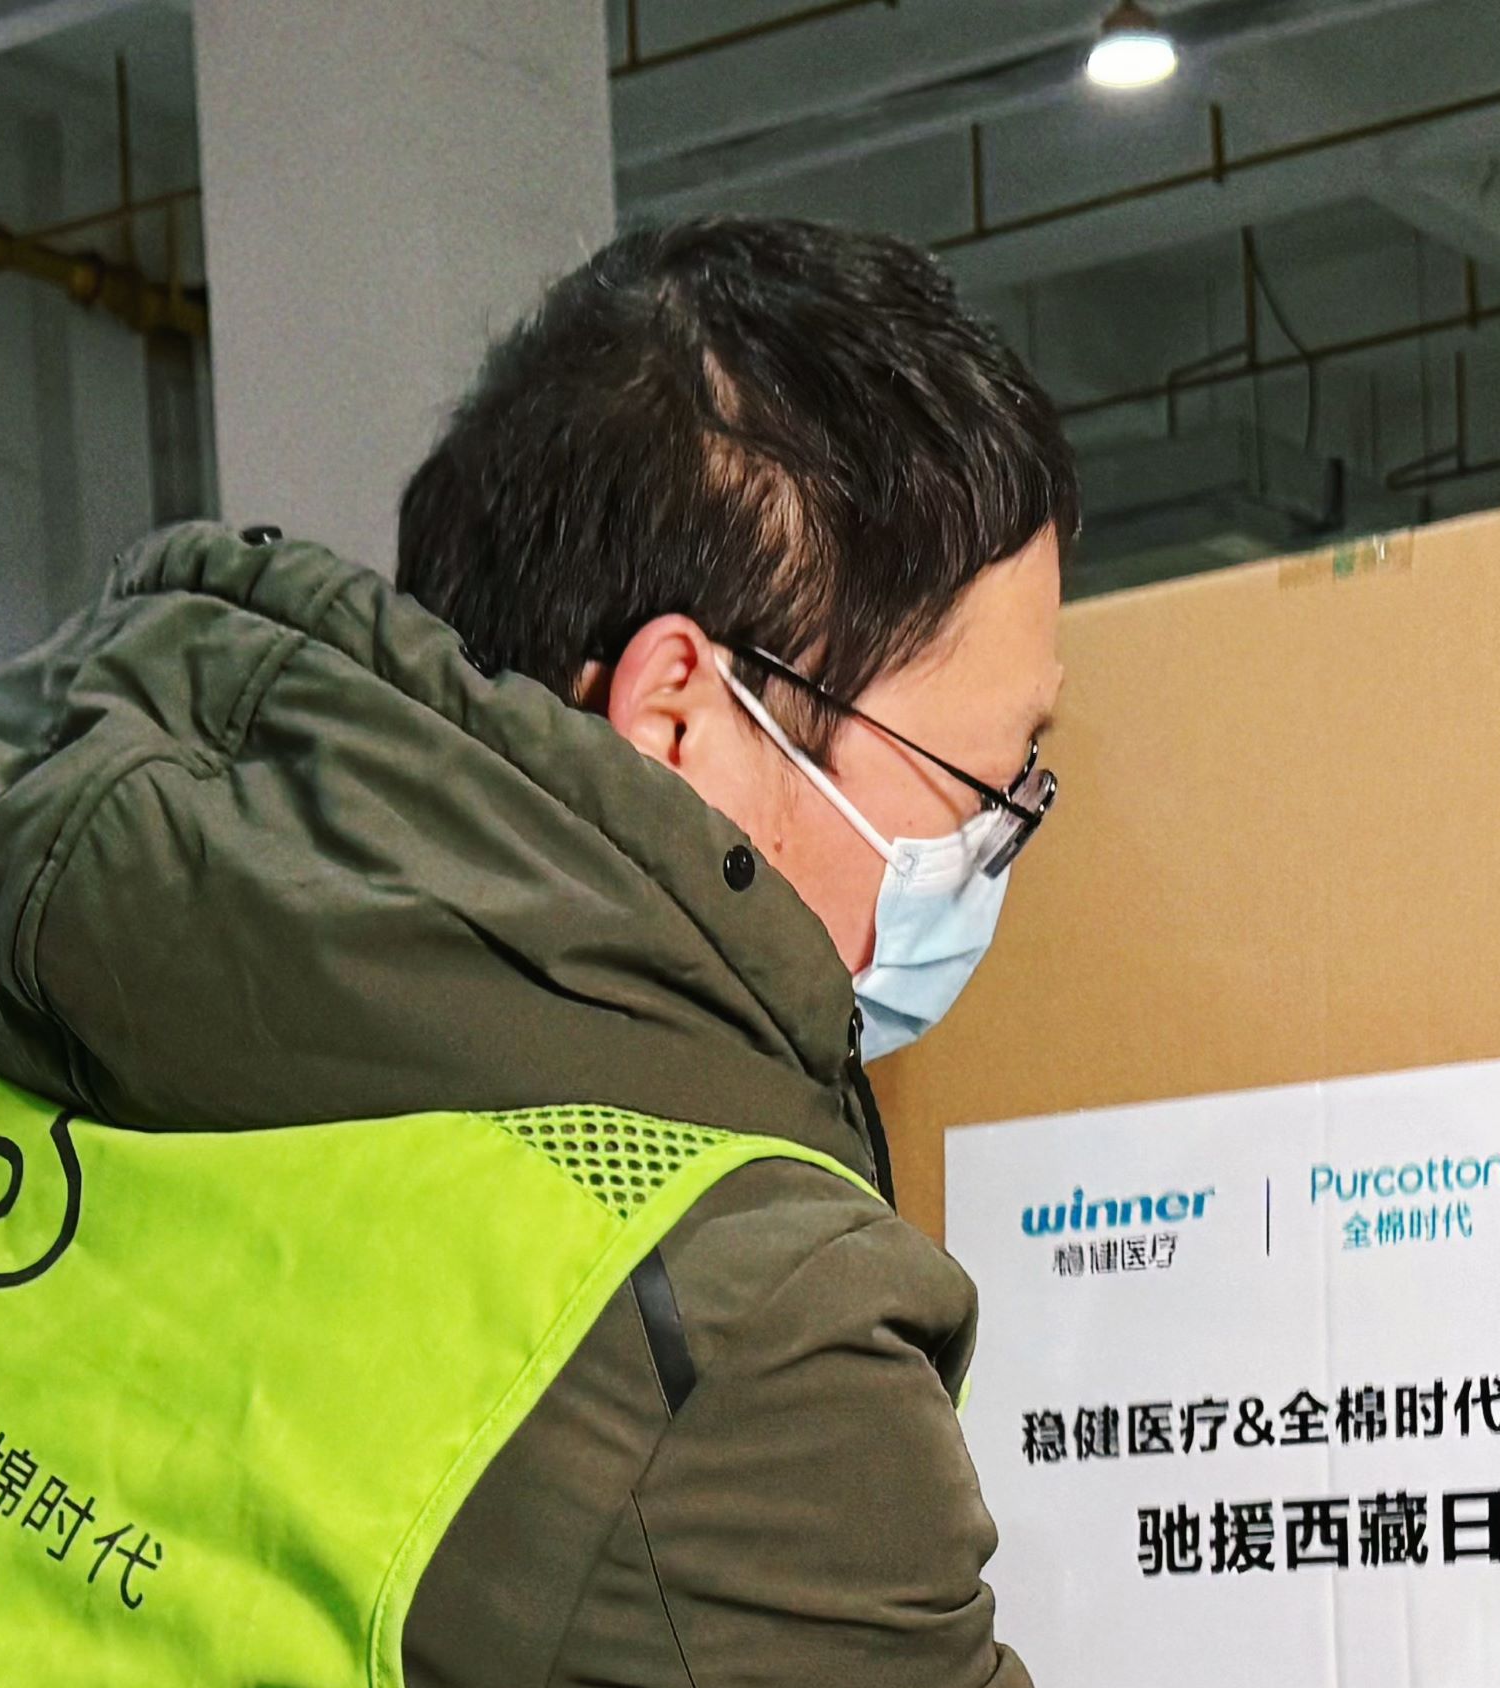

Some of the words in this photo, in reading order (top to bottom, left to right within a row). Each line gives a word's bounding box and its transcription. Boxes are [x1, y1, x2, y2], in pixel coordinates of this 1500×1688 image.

[1021, 1185, 1216, 1237] winner
[1340, 1201, 1473, 1250] 全棉时代
[1051, 1232, 1178, 1278] 稳健医疗
